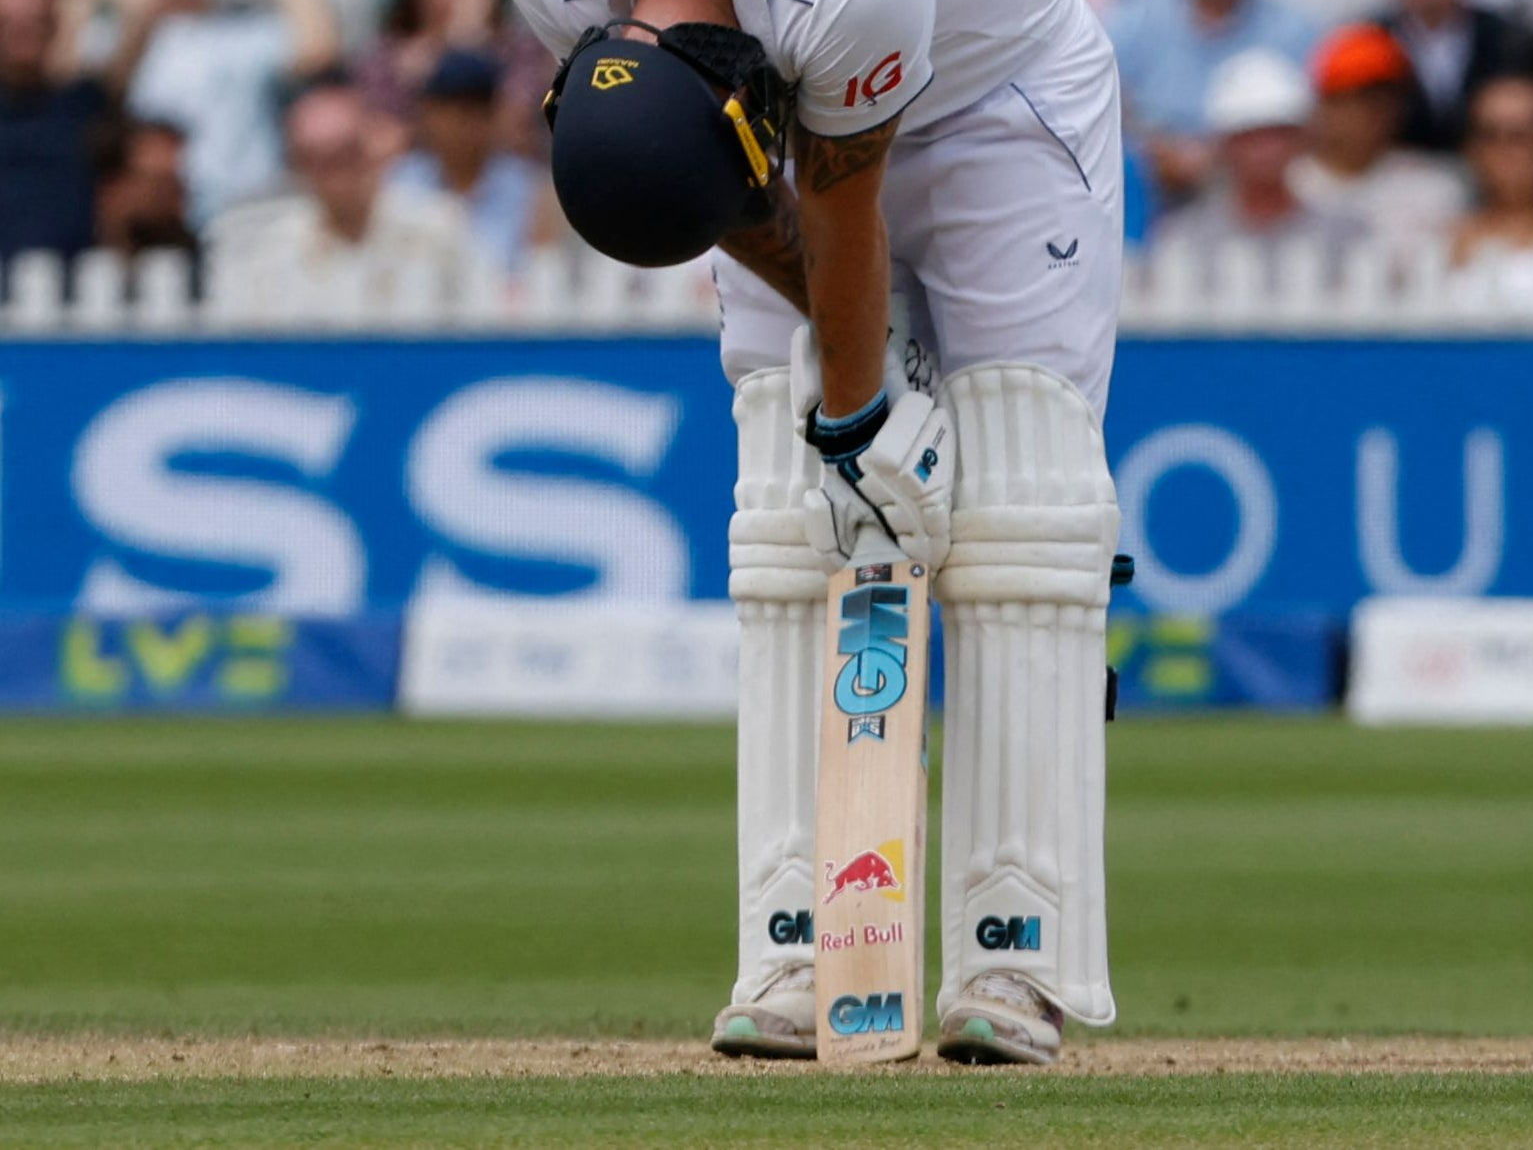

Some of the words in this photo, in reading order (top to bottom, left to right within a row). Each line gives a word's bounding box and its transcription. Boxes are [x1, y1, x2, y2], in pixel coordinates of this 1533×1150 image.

[843, 49, 903, 108] IG
[833, 583, 909, 716] GM
[821, 926, 854, 952] Red
[863, 921, 903, 945] Bull
[976, 915, 1041, 951] GM
[828, 992, 904, 1036] GM
